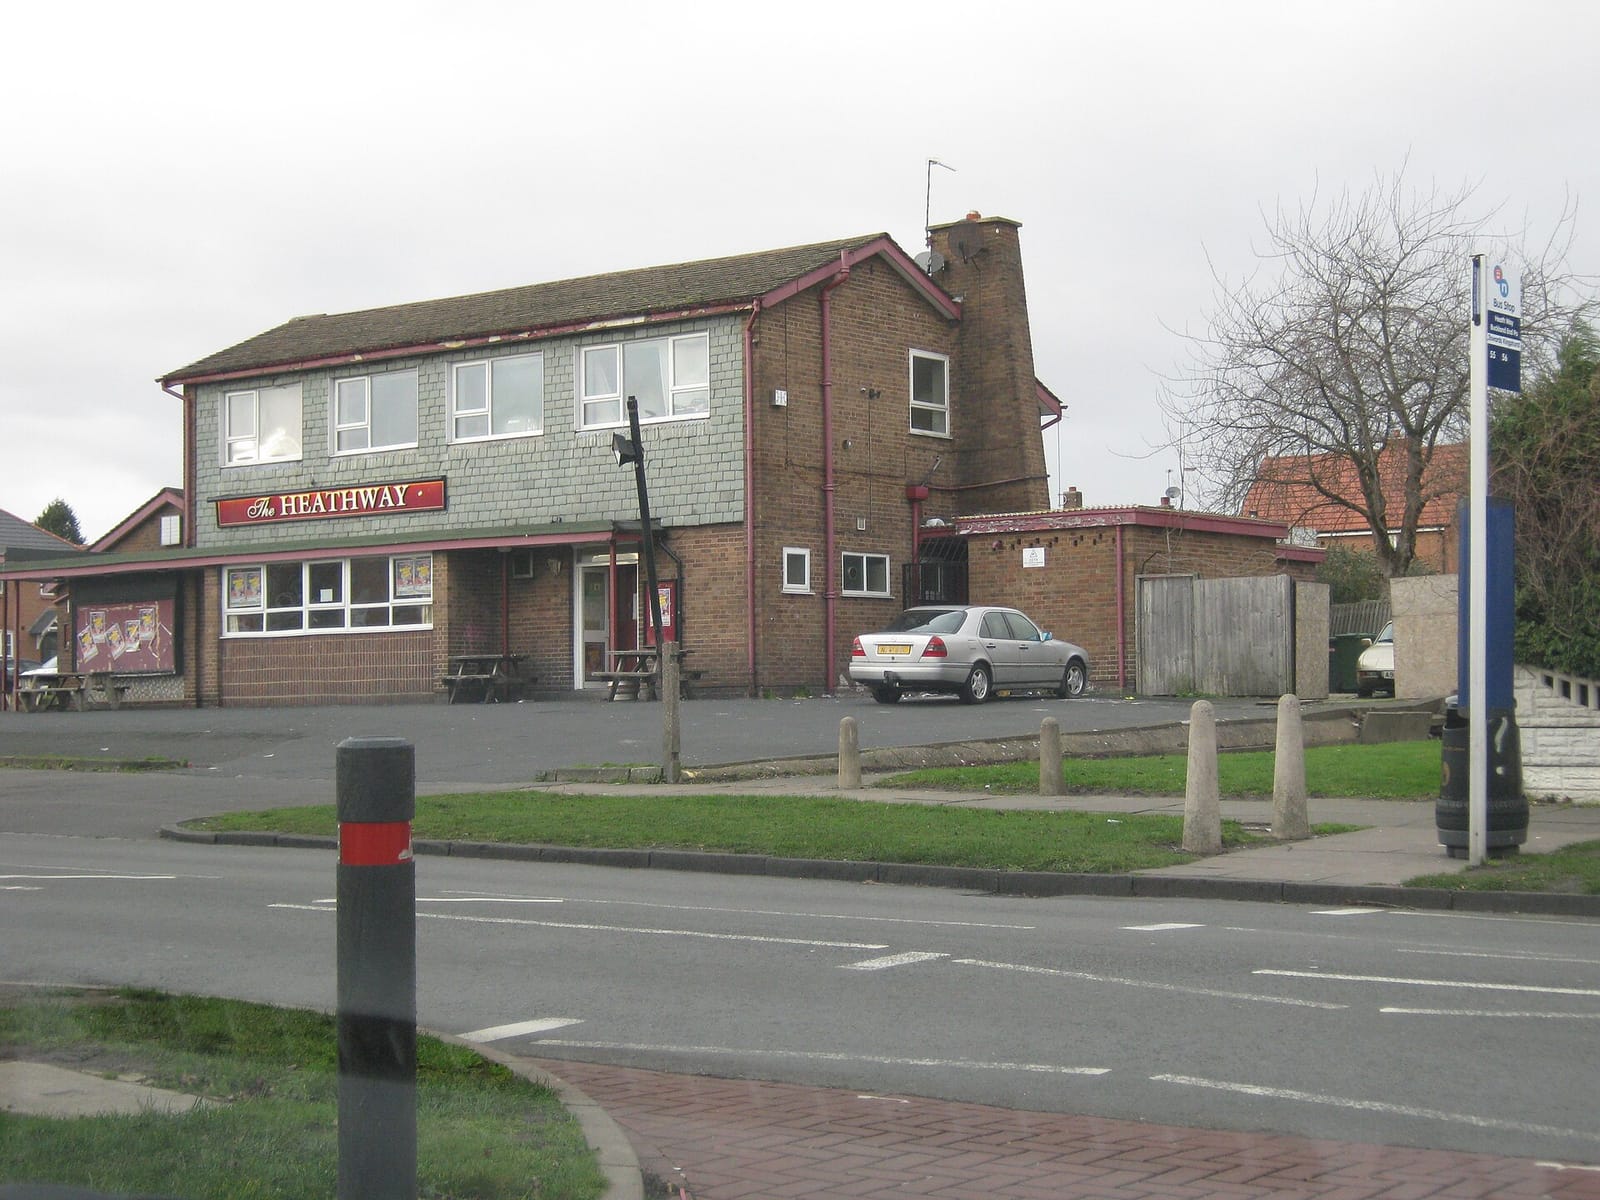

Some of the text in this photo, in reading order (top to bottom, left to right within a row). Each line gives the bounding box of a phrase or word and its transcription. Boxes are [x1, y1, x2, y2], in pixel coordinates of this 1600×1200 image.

[1493, 298, 1515, 313] Bus Stop
[247, 484, 409, 518] The HEATHWAY
